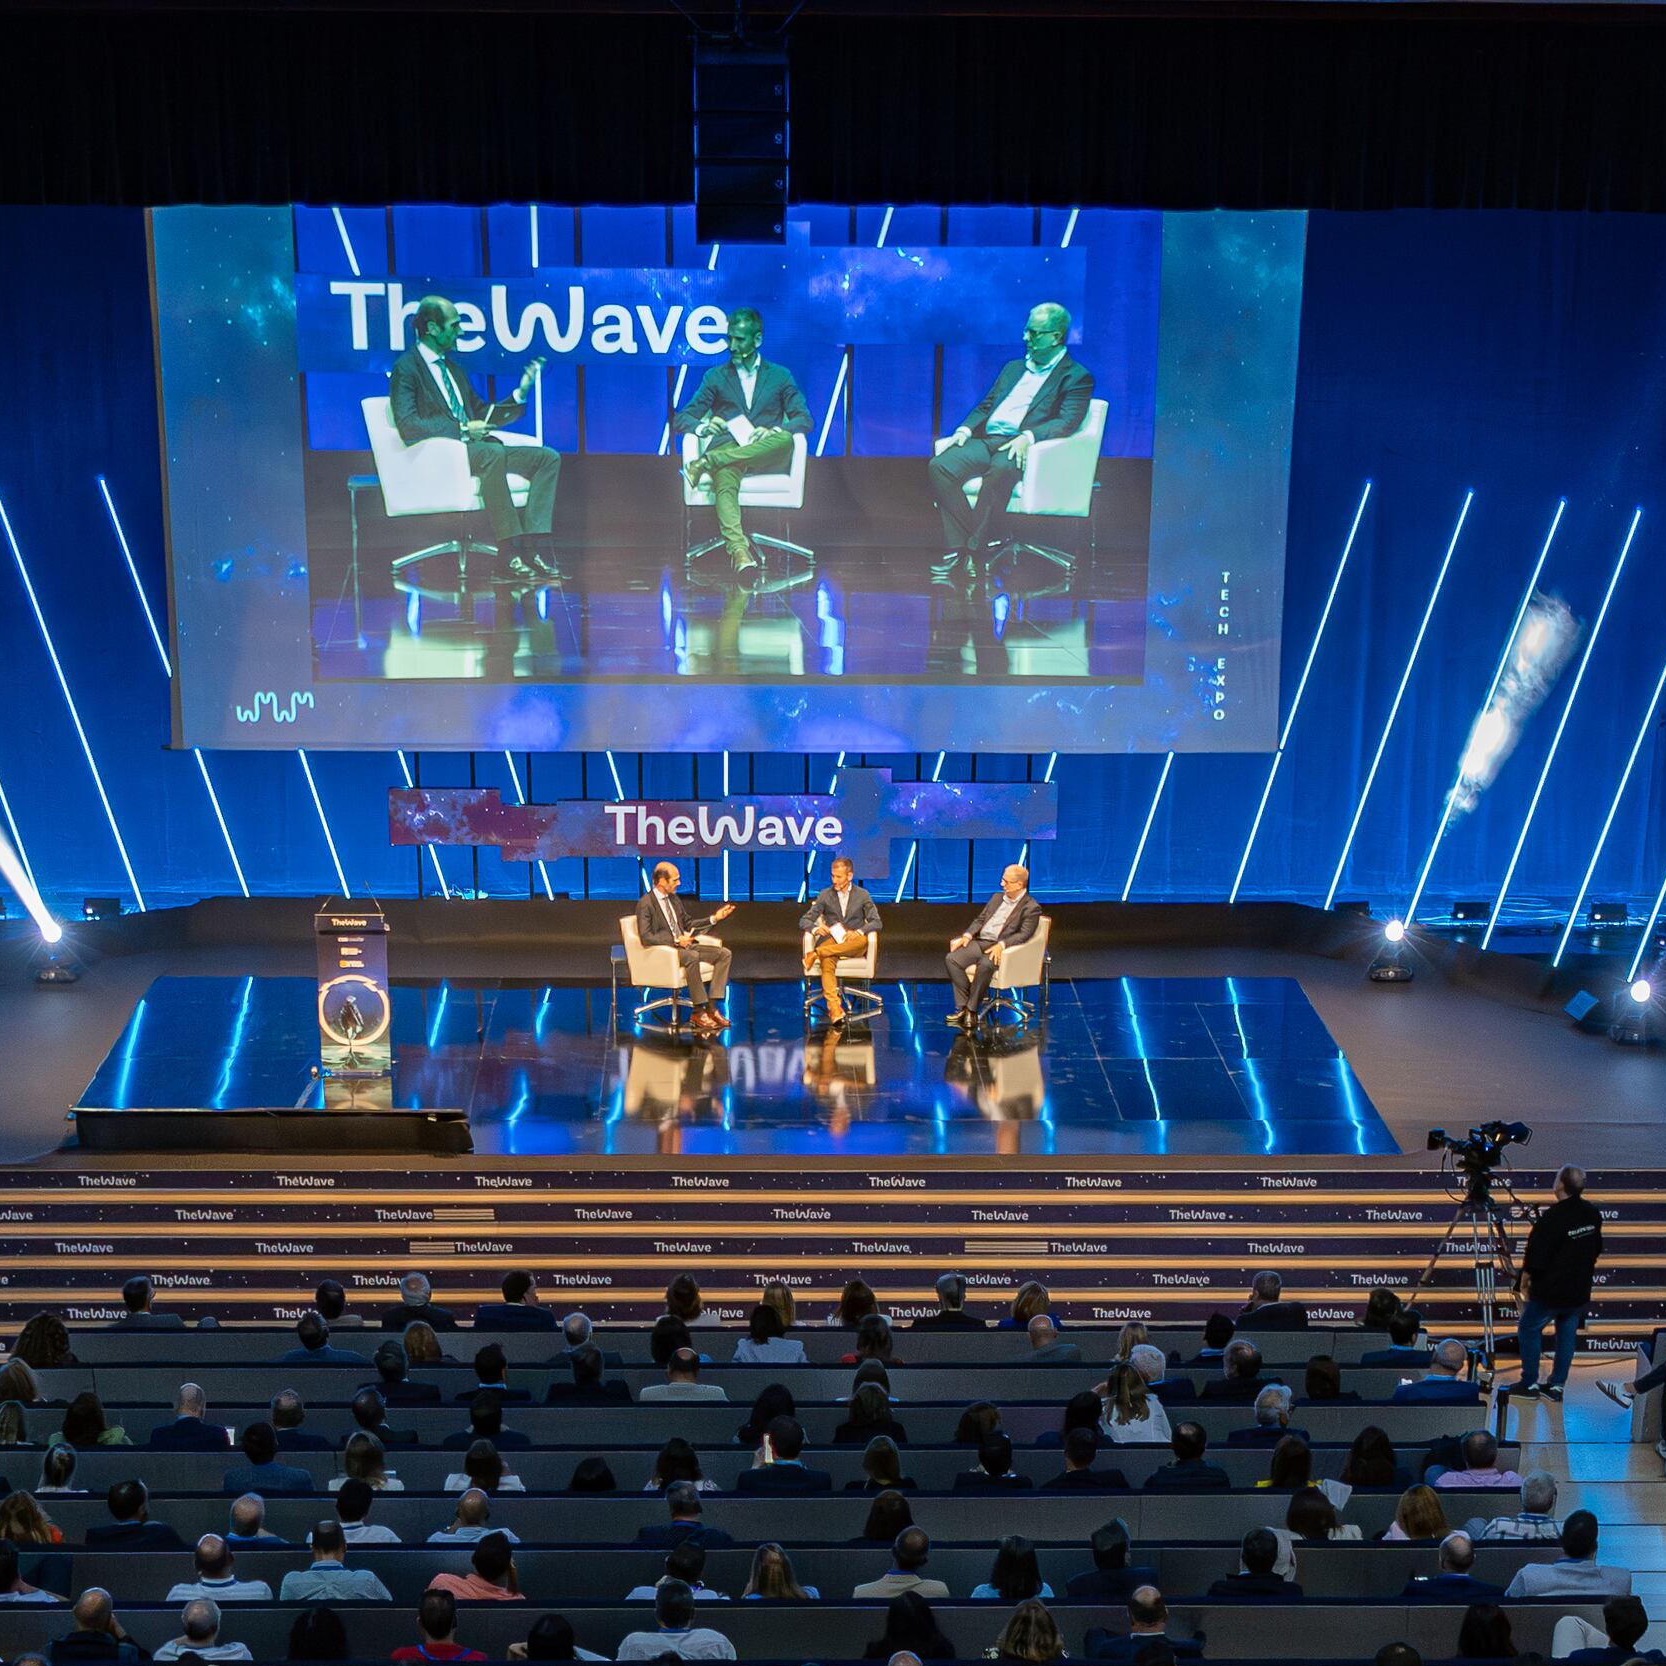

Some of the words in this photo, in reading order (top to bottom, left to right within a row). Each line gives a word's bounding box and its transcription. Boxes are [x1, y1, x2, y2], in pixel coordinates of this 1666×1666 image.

[330, 281, 729, 354] TheWave
[1217, 571, 1231, 635] TECH
[1213, 657, 1226, 721] EXPO
[604, 805, 843, 846] TheWave
[78, 1175, 136, 1186] TheWave
[277, 1176, 335, 1187] TheWave
[475, 1176, 532, 1187] TheWave
[672, 1176, 730, 1187] TheWave
[869, 1176, 926, 1187] TheWave
[1065, 1177, 1122, 1187] TheWave
[1261, 1177, 1317, 1187] TheWave
[175, 1209, 233, 1220] TheWave
[375, 1209, 433, 1220] TheWave
[575, 1208, 633, 1220] TheWave
[773, 1208, 831, 1220] TheWave
[971, 1210, 1029, 1221] TheWave
[1169, 1209, 1226, 1220] TheWave
[1366, 1210, 1422, 1220] TheWave
[55, 1242, 113, 1253] TheWave
[255, 1242, 313, 1253] TheWave
[455, 1241, 513, 1252] TheWave
[654, 1242, 711, 1252] TheWave
[852, 1242, 910, 1252] TheWave
[1050, 1242, 1107, 1252] TheWave
[1247, 1243, 1304, 1253] TheWave
[152, 1275, 210, 1286] TheWave
[554, 1275, 612, 1285] TheWave
[1153, 1274, 1210, 1285] TheWave
[1351, 1274, 1408, 1285] TheWave
[67, 1308, 127, 1319] TheWave
[889, 1307, 940, 1318] TheWav
[1093, 1307, 1151, 1318] TheWave
